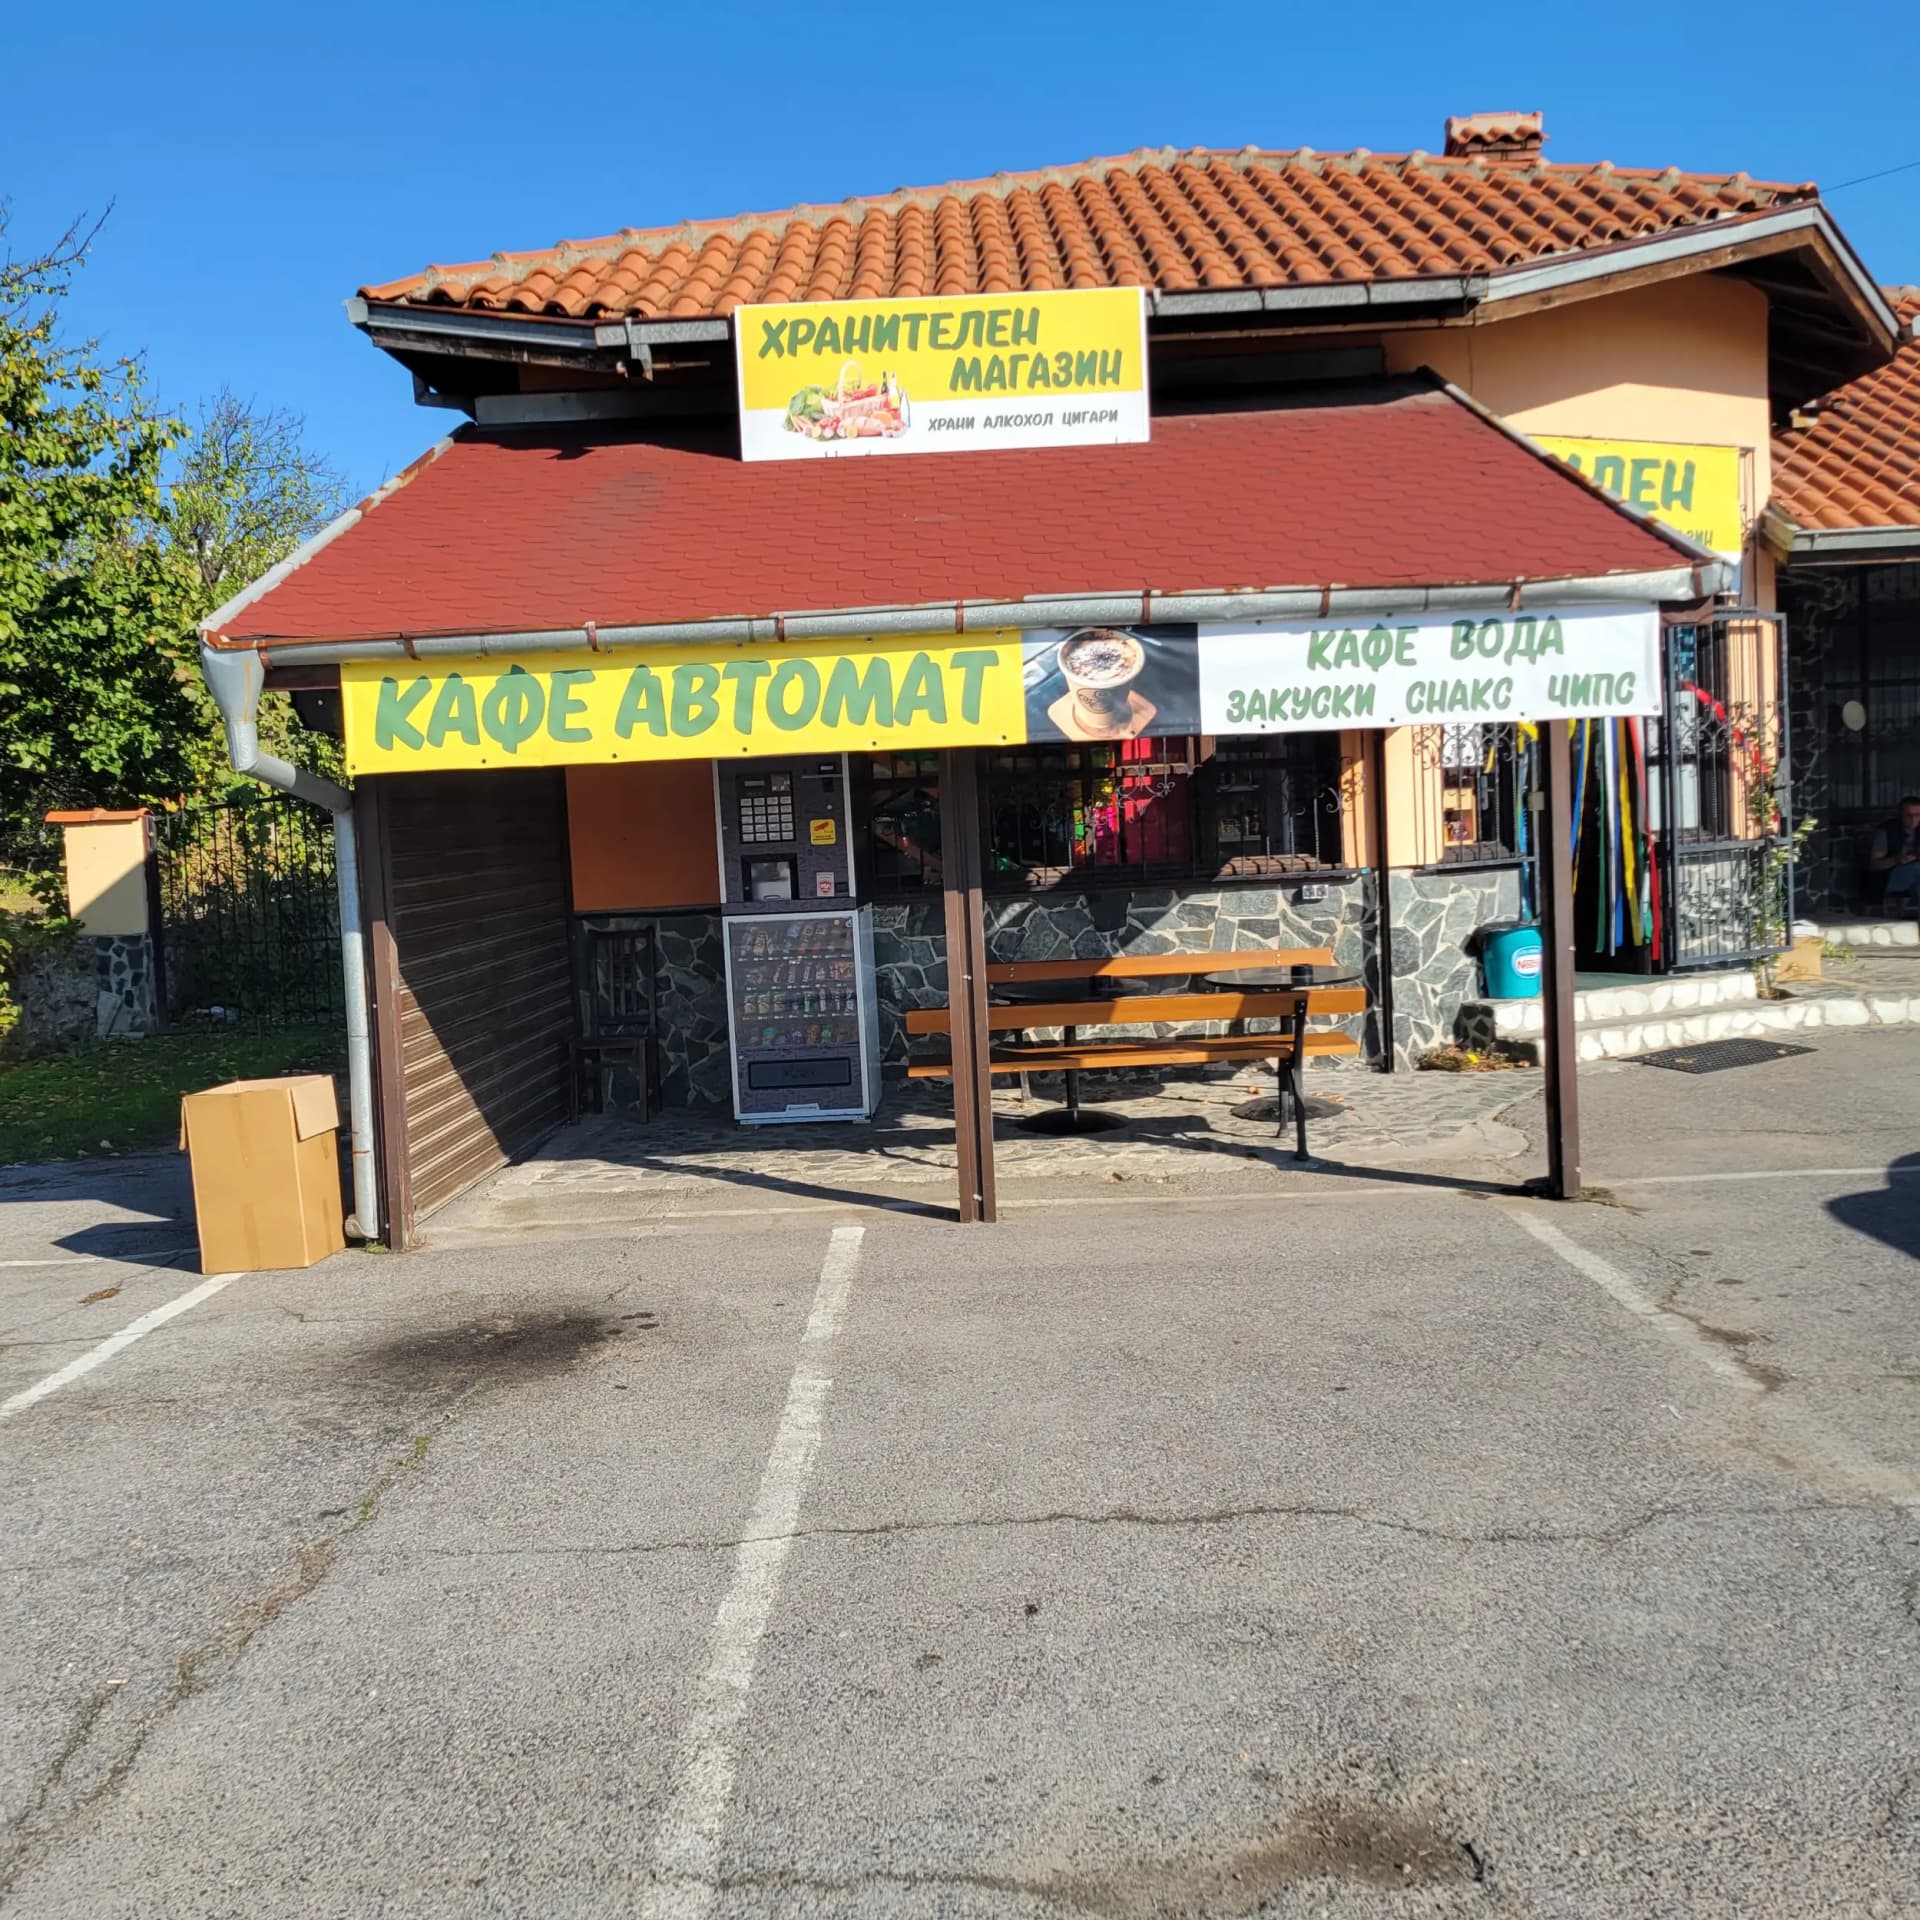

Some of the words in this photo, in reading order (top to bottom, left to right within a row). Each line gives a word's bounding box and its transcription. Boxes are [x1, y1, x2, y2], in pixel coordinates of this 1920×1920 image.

[758, 307, 1040, 359] ХРАНИТЕЛЕН
[949, 349, 1123, 392] МАГАЗИН
[927, 416, 976, 432] ХРАНИ
[983, 412, 1054, 429] АЛКОХОЛ
[1062, 409, 1119, 426] ЦИГАРИ
[1567, 453, 1696, 512] ЛЕН
[1307, 622, 1419, 672] КАФЕ
[1449, 614, 1564, 666] ВОДА
[375, 664, 595, 754] КАФЕ
[614, 649, 1000, 739] АВТОМАТ
[1226, 683, 1377, 722] ЗАКУСКИ
[1405, 676, 1513, 713] СНАКС
[1548, 670, 1636, 706] ЧИПС
